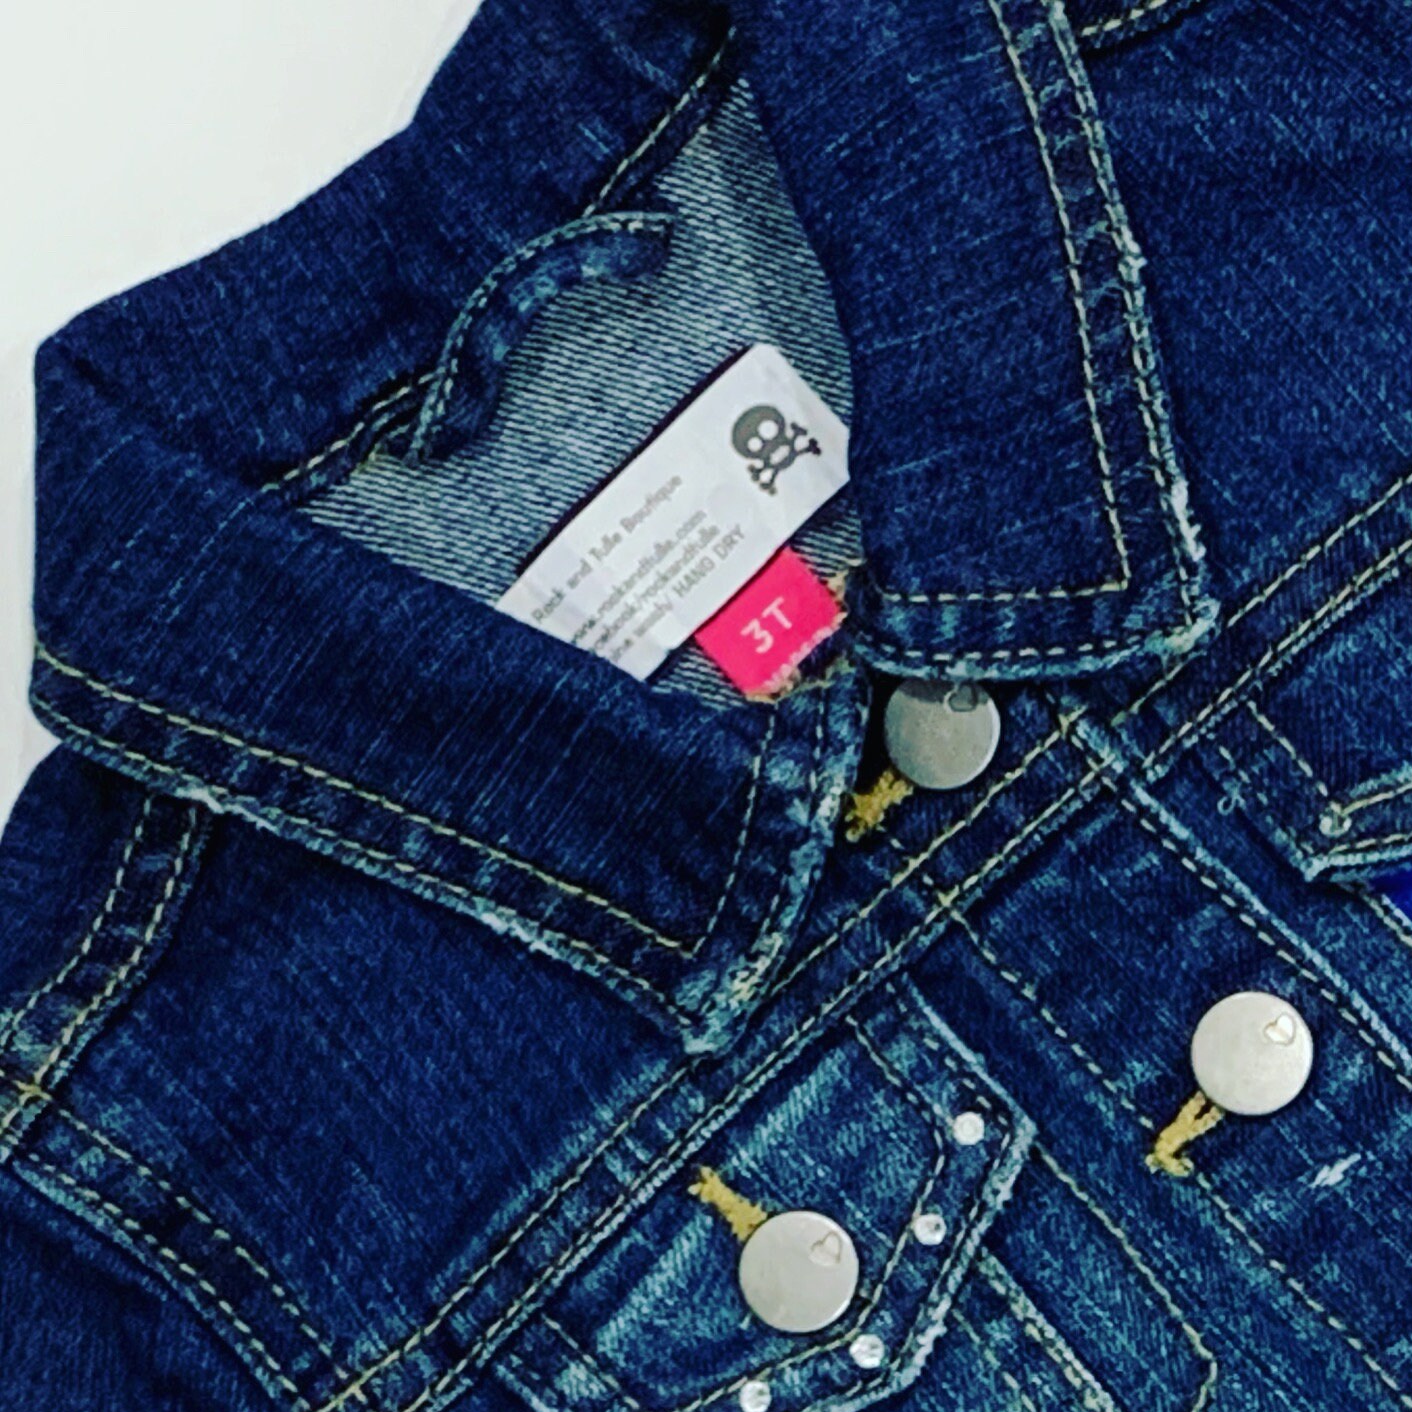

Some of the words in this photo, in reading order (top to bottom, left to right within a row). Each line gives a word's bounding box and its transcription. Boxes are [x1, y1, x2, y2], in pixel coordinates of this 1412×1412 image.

[531, 587, 565, 623] Rock
[567, 558, 592, 589] and
[590, 532, 622, 561] Tulle
[620, 475, 682, 533] Boutique
[672, 556, 716, 597] HANG
[712, 523, 745, 560] DRY
[741, 597, 792, 654] 3T
